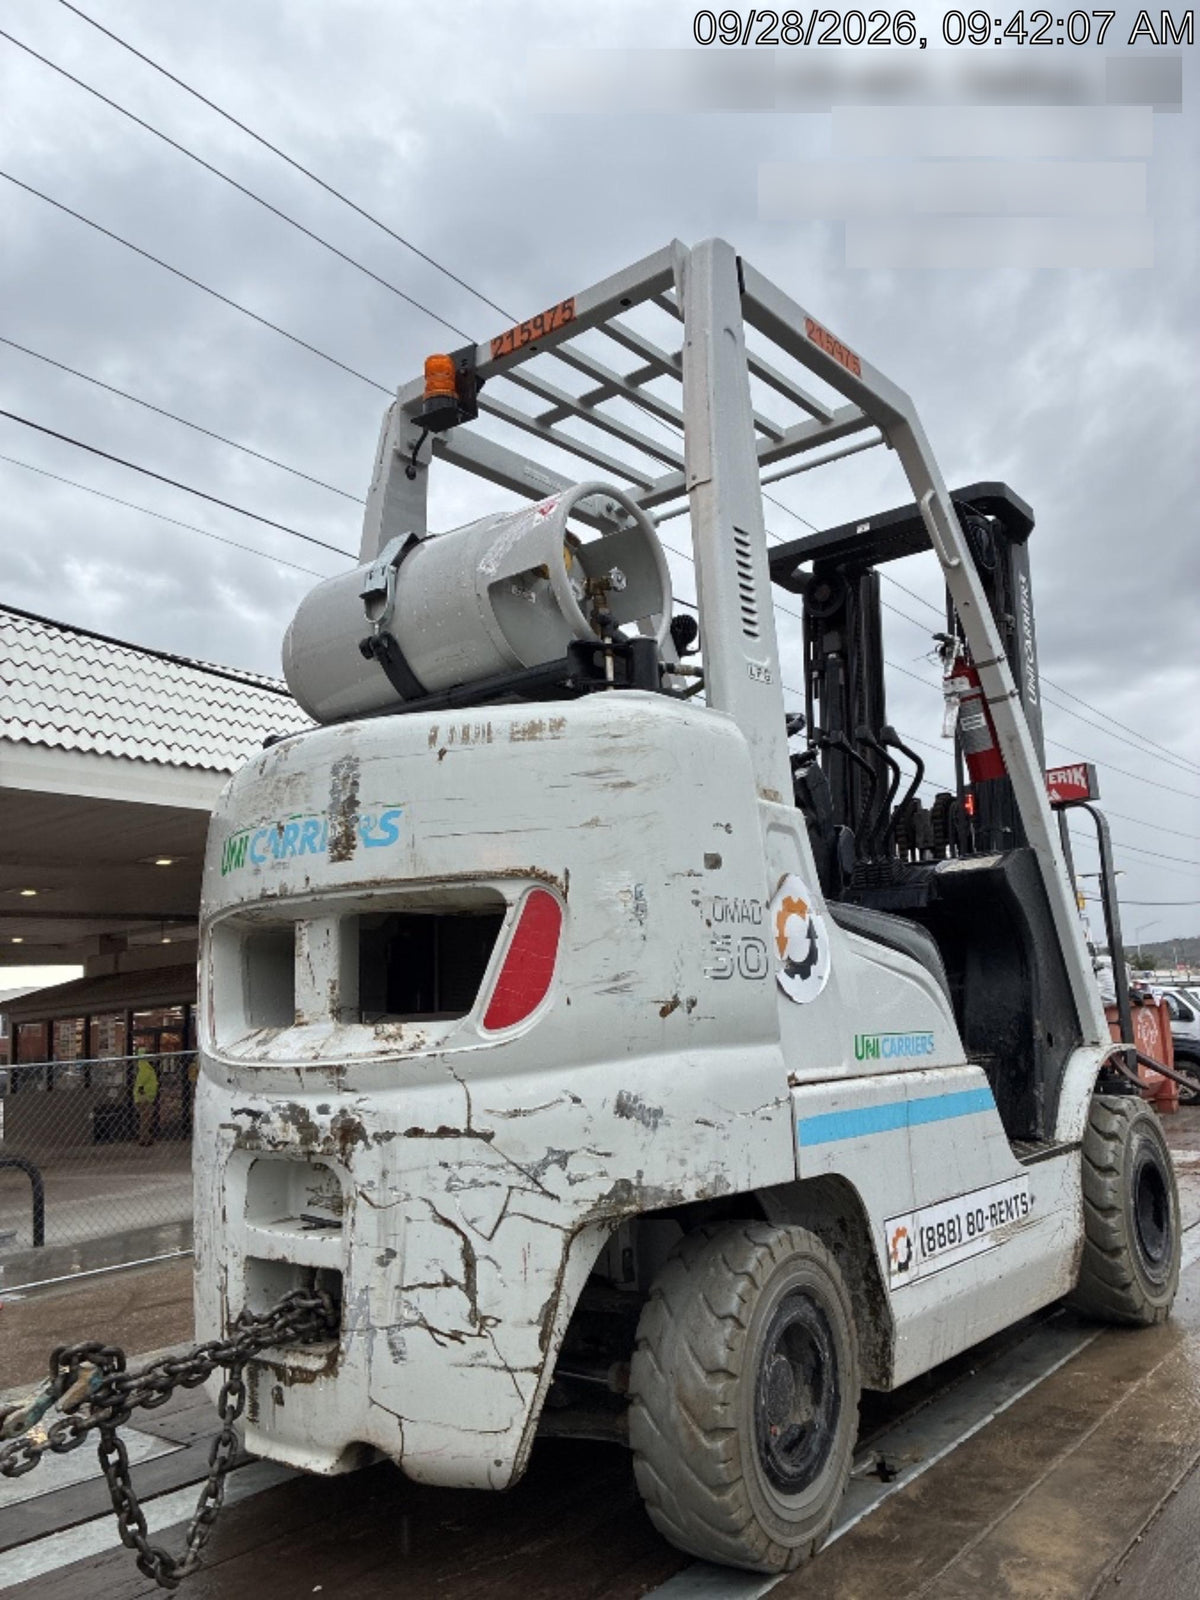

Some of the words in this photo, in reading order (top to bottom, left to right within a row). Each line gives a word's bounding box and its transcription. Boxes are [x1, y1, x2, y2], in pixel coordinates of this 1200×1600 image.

[491, 296, 576, 360] 215975
[806, 318, 861, 377] 215975
[221, 809, 403, 877] UNICARRIRS
[700, 896, 763, 926] OMAD
[920, 1214, 963, 1258] (888)
[966, 1192, 1029, 1237] 80-RENTS
